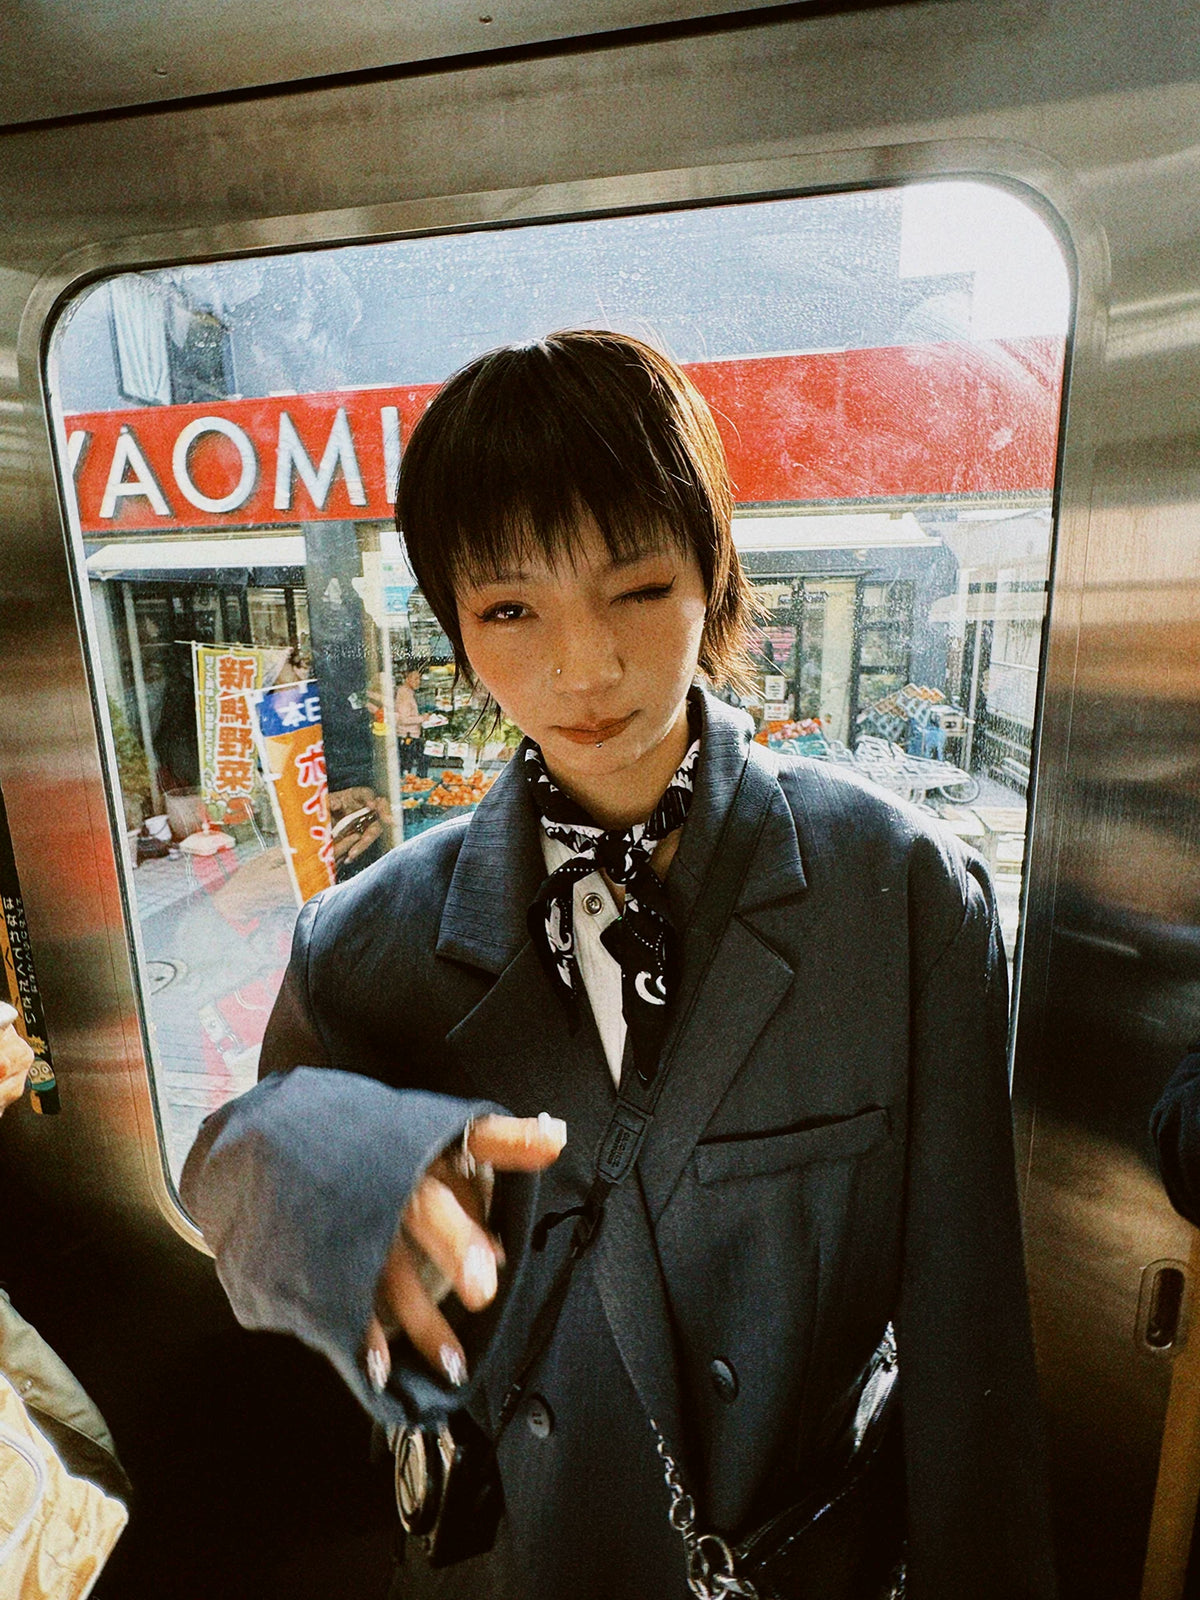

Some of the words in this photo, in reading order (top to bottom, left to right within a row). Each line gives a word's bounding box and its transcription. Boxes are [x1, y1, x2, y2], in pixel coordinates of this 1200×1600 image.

[216, 655, 254, 794] 新鮮野菜
[278, 696, 322, 728] 本日
[3, 897, 37, 1025] はなれてください
